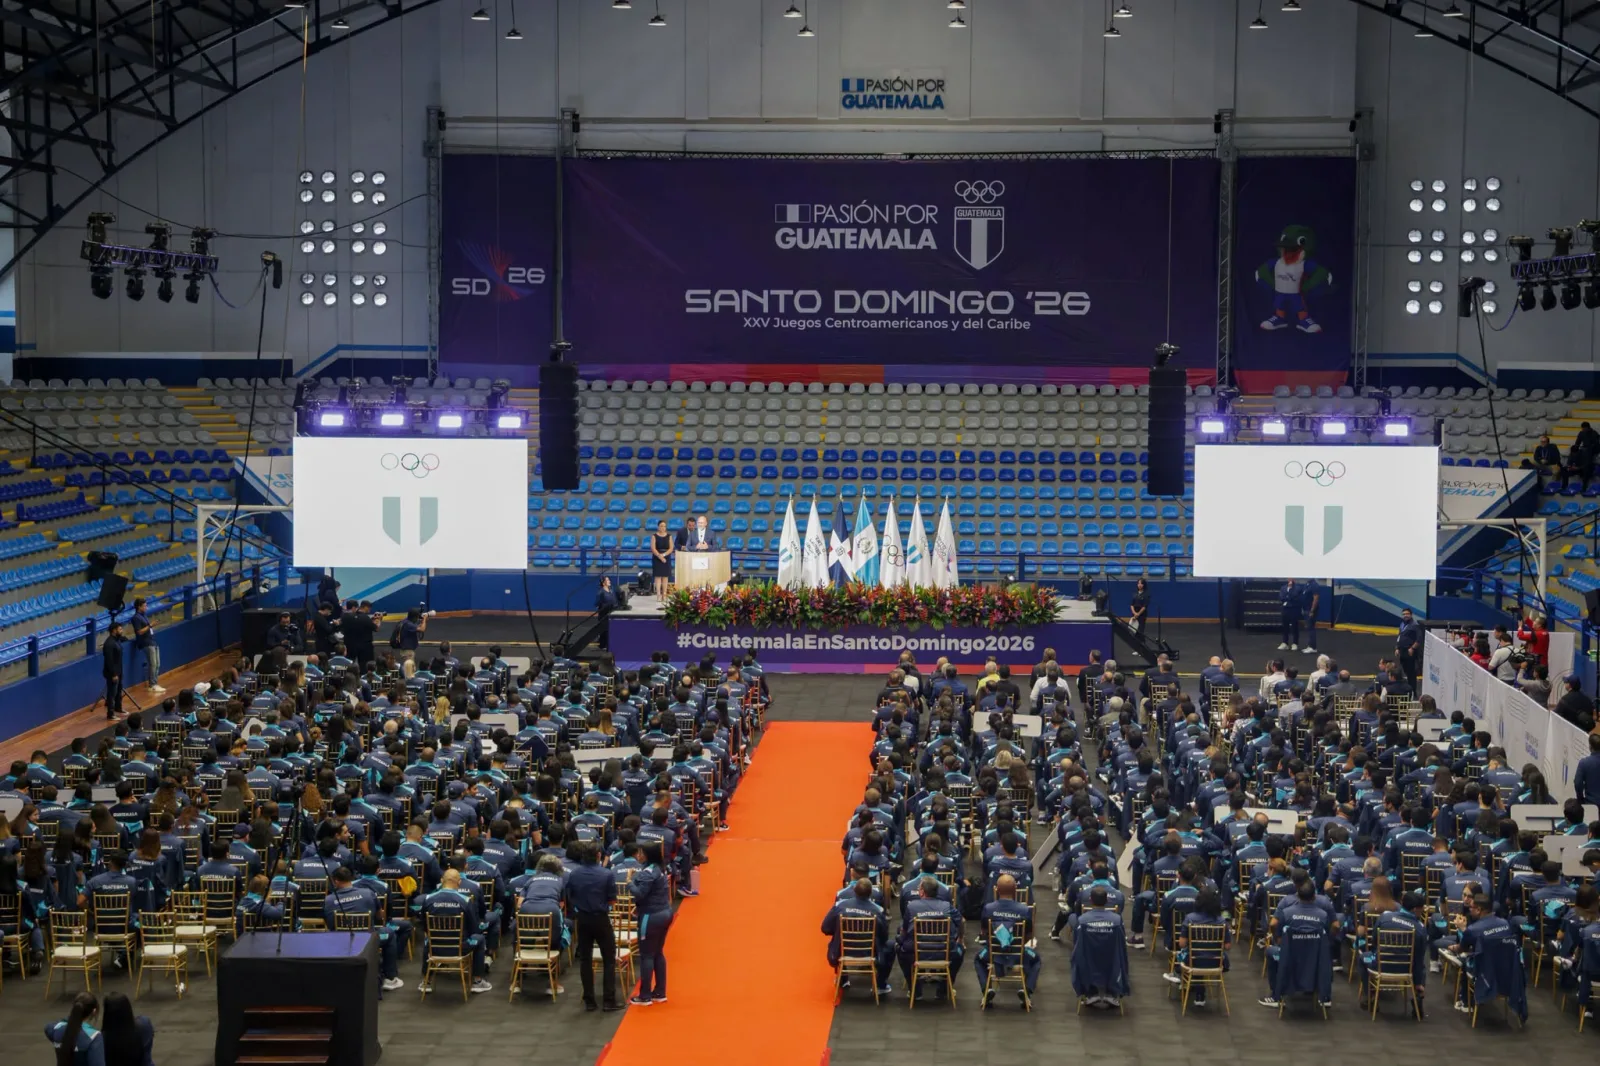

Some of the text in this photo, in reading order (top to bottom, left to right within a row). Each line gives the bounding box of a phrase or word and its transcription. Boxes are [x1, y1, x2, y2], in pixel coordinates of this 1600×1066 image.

[866, 76, 945, 92] PASIÓN POR
[841, 94, 944, 109] GUATEMALA
[814, 200, 938, 224] PASIÓN POR
[957, 208, 1002, 218] GUATEMALA
[775, 227, 938, 250] GUATEMALA
[452, 267, 546, 295] SD 26
[685, 289, 822, 313] SANTO
[834, 290, 1014, 315] DOMINGO
[743, 317, 1031, 331] XXV Juegos Centroamericanos y del Caribe
[676, 632, 1035, 655] #GuatemalaEnSantoDomingo2026
[845, 907, 872, 916] GUATEMALA
[993, 911, 1021, 919] GUATEMALA
[1292, 914, 1320, 922] GUATEMALA
[1391, 916, 1415, 928] GUATEMALA
[1483, 925, 1509, 936] GUATEMALA
